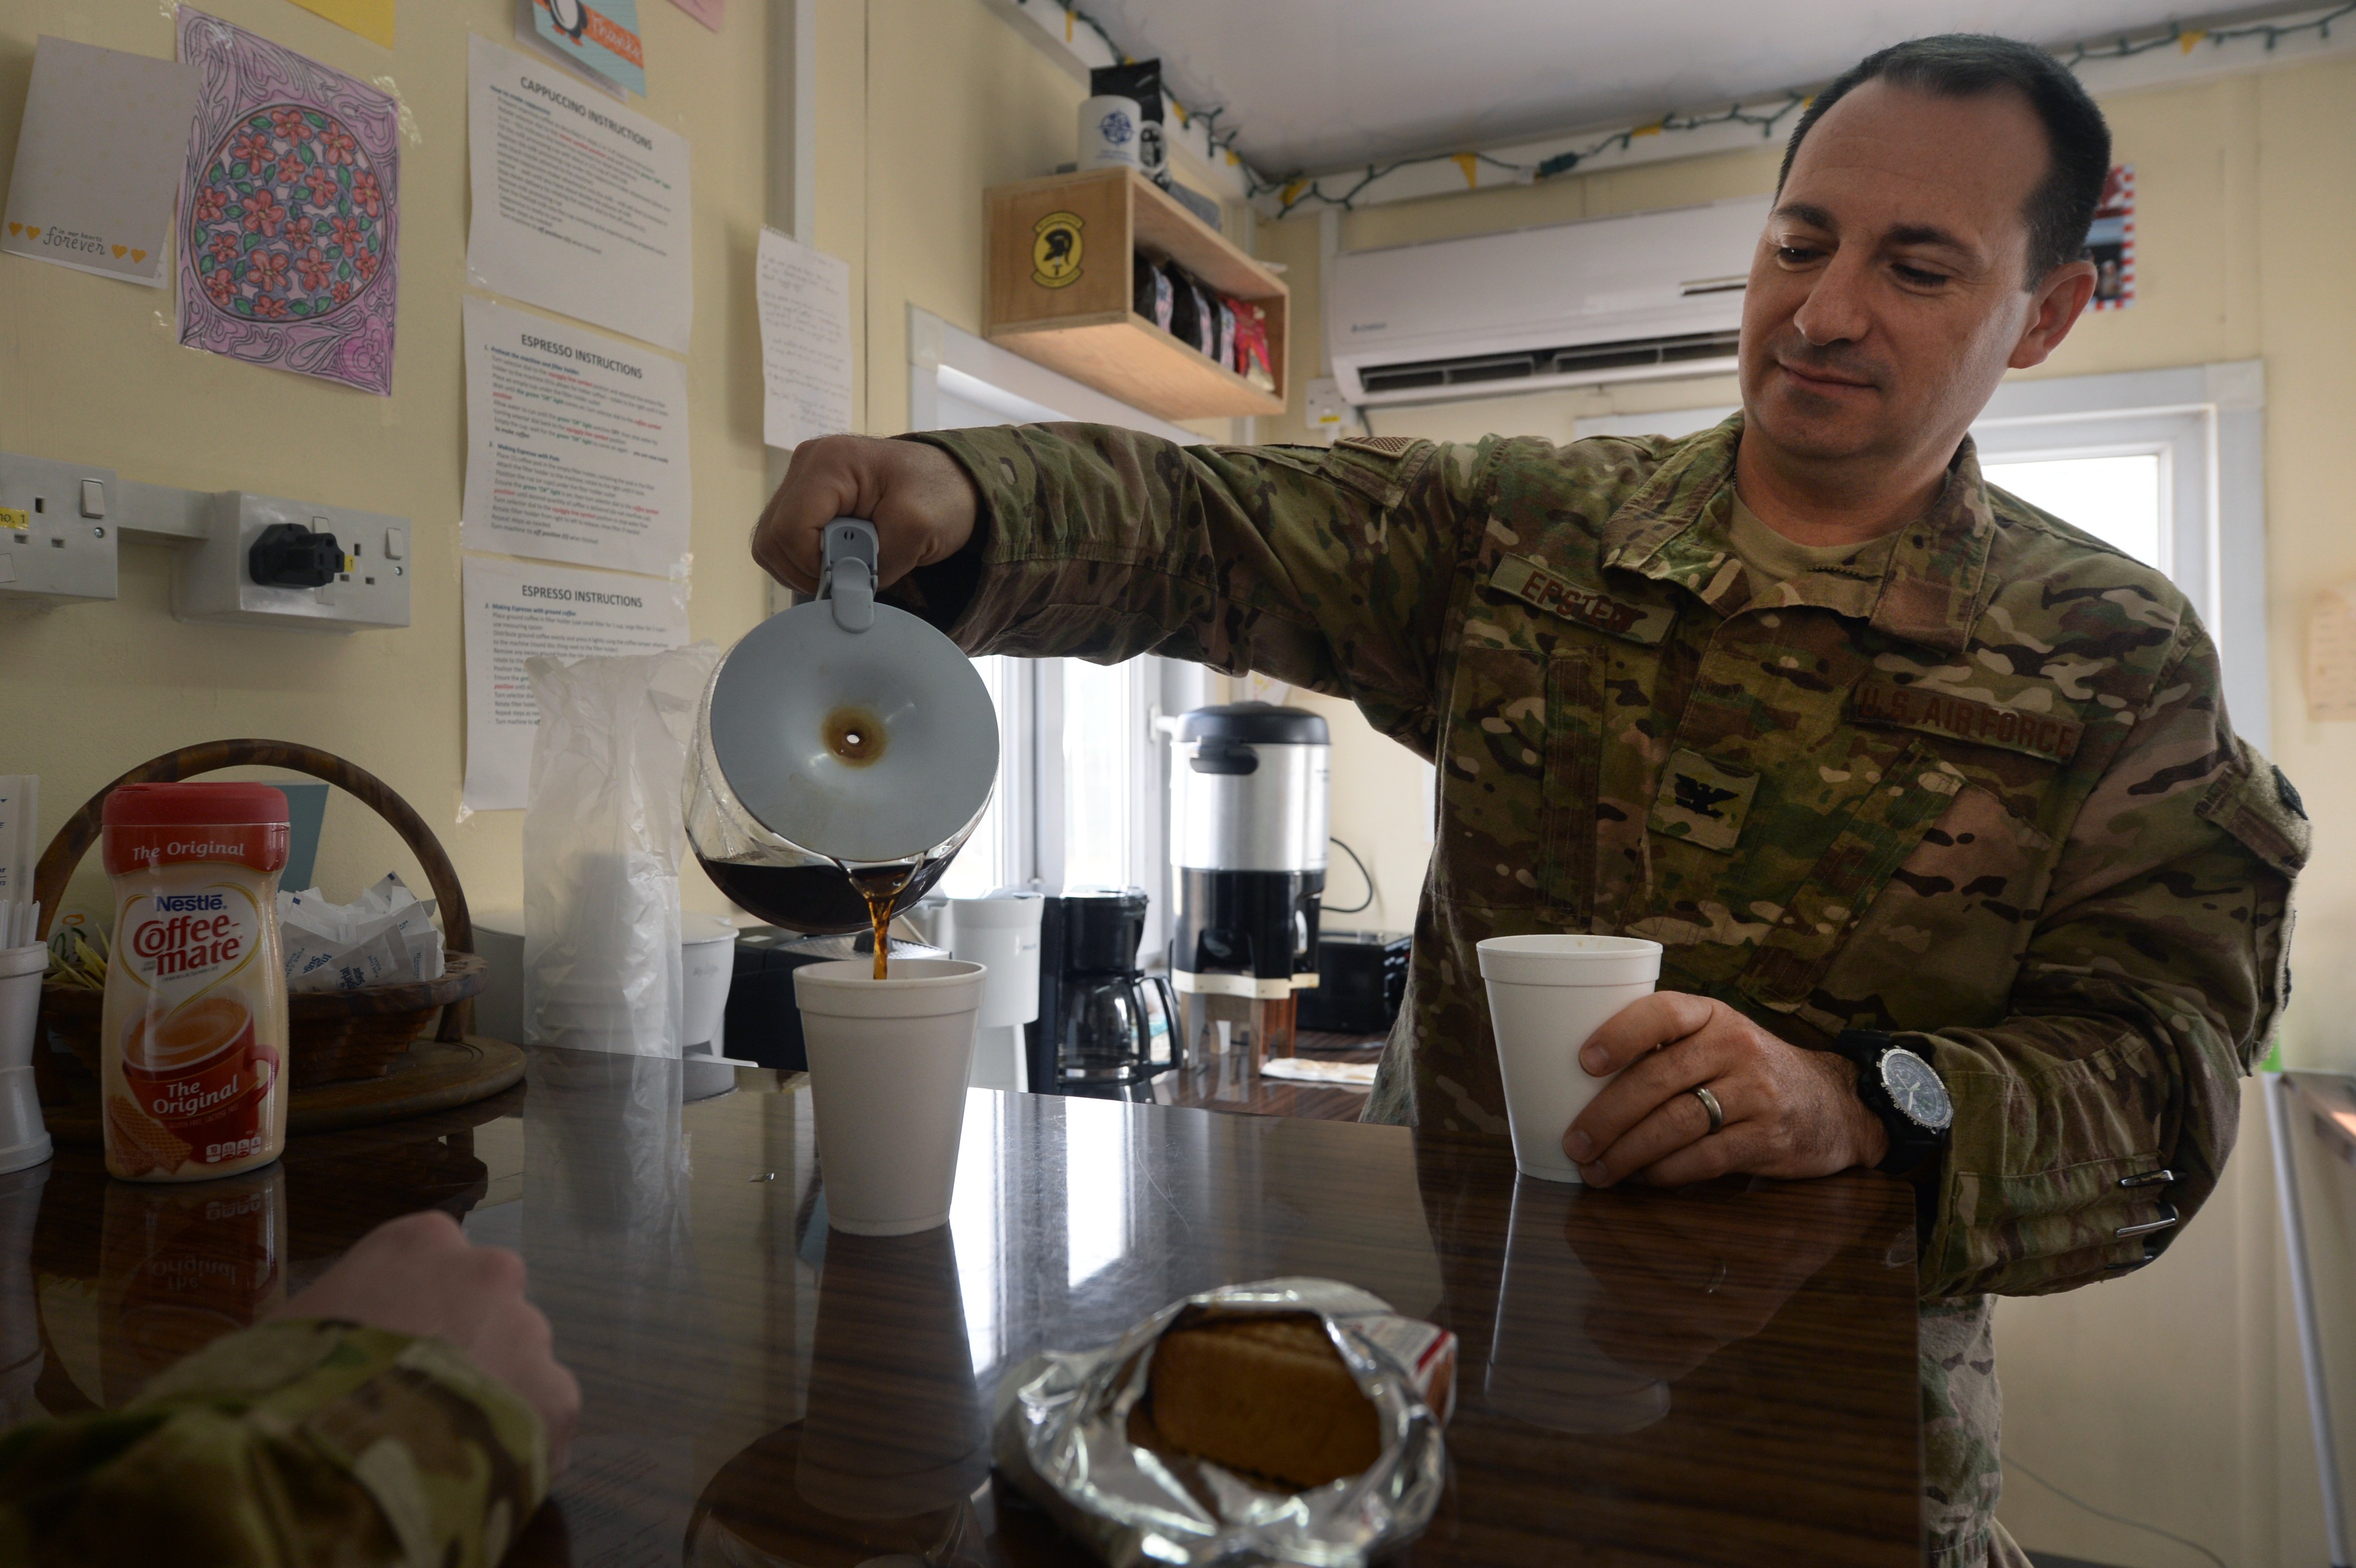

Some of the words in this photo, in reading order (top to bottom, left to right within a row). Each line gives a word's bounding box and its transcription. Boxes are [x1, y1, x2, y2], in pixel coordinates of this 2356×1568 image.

[521, 76, 586, 117] CAPPUCCINO
[588, 109, 653, 150] INSTRUCTIONS
[43, 226, 106, 256] forever
[80, 232, 103, 242] hearts
[521, 334, 573, 358] ESPRESSO
[575, 348, 643, 379] INSTRUCTIONS
[521, 584, 572, 602] ESPRESSO
[575, 591, 642, 608] INSTRUCTIONS
[1861, 687, 1916, 721] U.S.
[1922, 696, 1976, 739] AIR
[1979, 708, 2075, 758] FORCE
[133, 845, 160, 861] The
[167, 841, 245, 858] Original
[156, 938, 240, 976] mate
[353, 967, 366, 987] Sugar
[153, 1074, 239, 1116] Original
[167, 1082, 200, 1098] The
